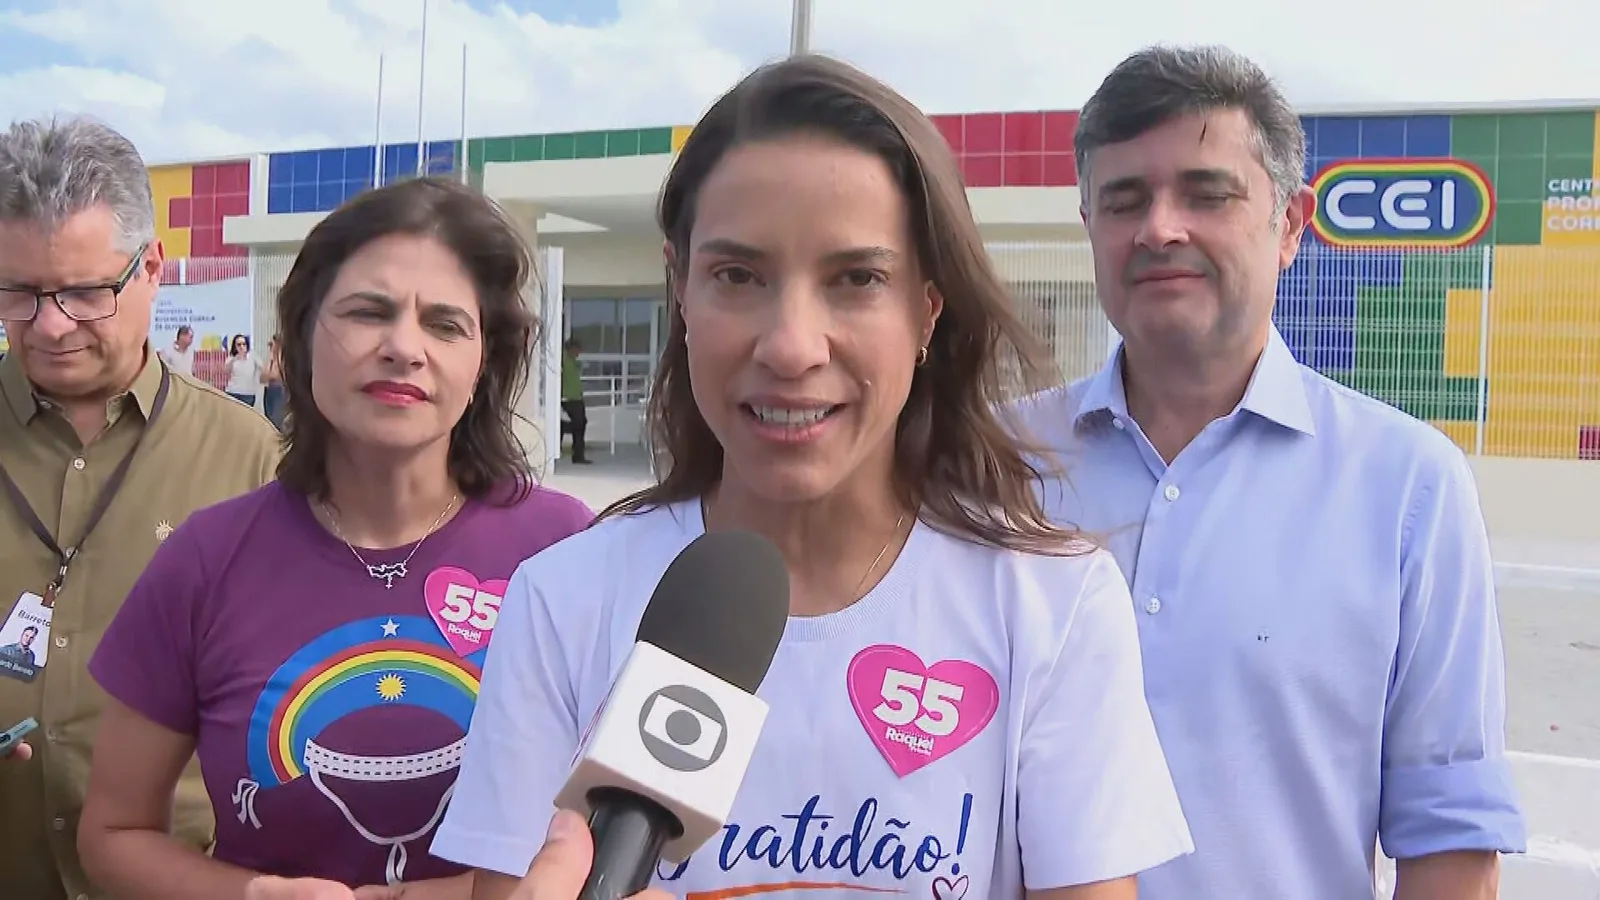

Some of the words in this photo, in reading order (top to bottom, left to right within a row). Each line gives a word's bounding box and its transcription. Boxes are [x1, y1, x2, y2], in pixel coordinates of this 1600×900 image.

[1325, 179, 1455, 230] CEI
[438, 582, 503, 631] 55
[872, 667, 965, 737] 55
[884, 726, 935, 751] Raquel
[656, 792, 974, 880] ratidão!
